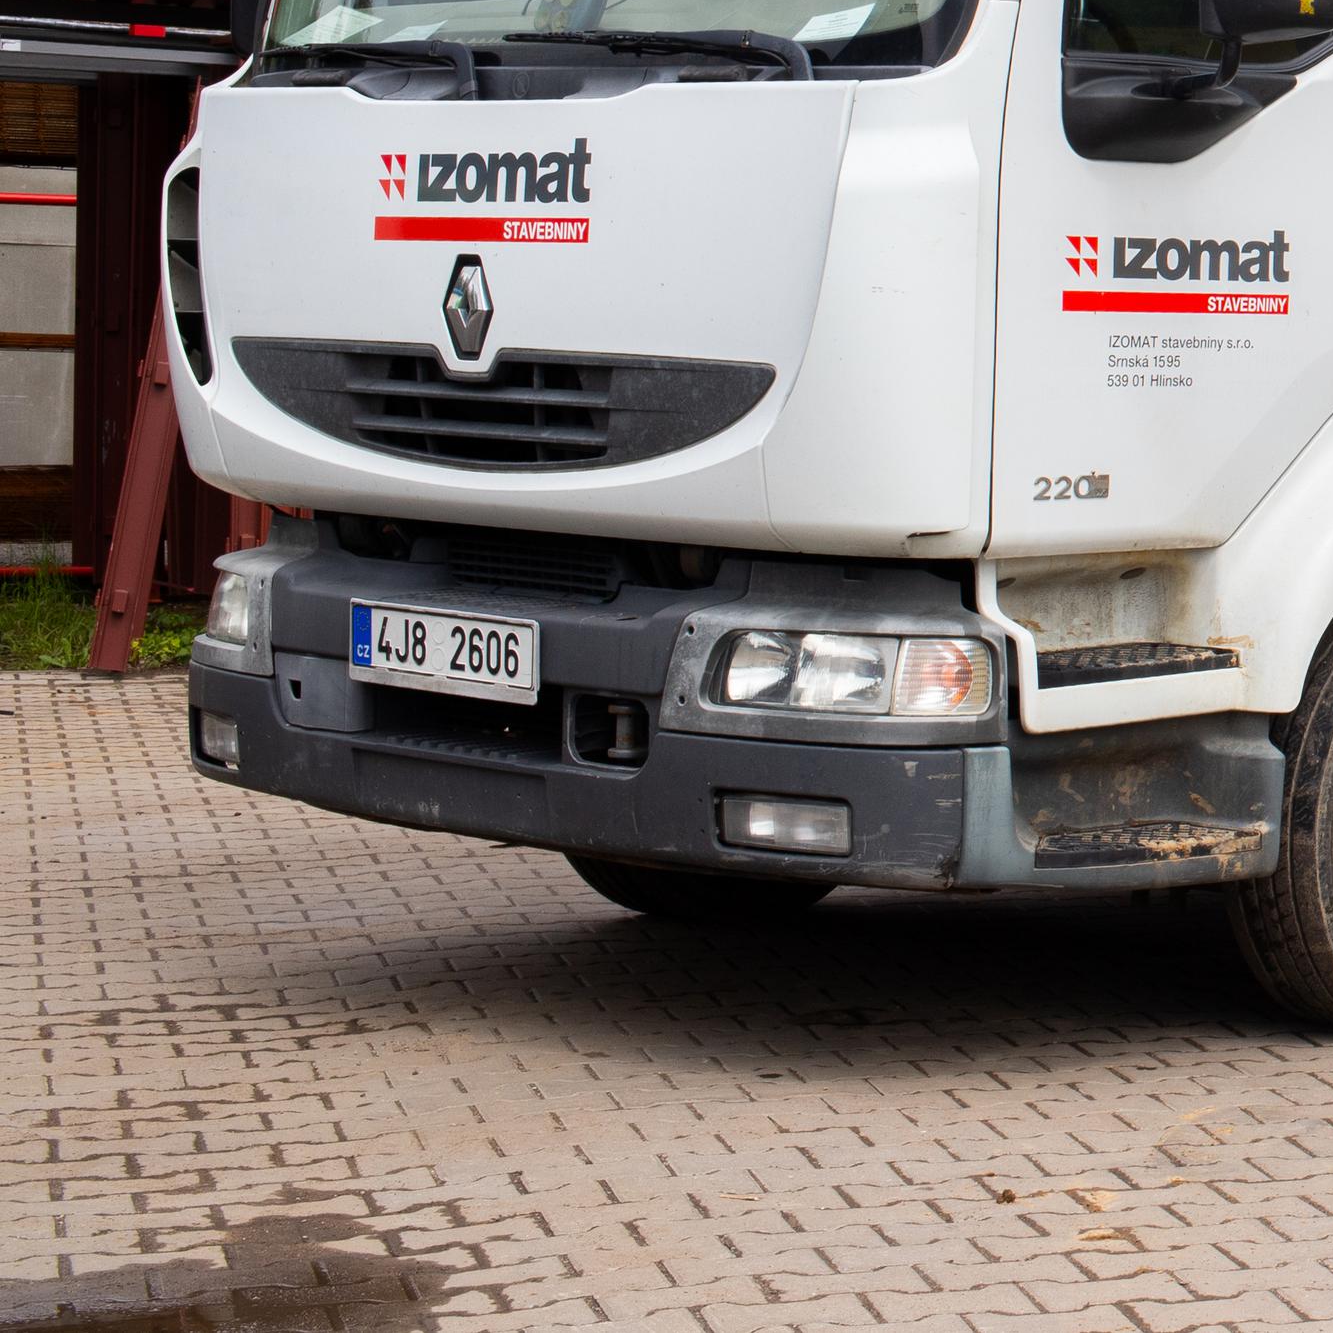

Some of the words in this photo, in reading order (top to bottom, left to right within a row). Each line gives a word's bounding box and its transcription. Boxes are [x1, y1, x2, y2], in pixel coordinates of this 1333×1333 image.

[503, 221, 587, 240] STAVEBNINY
[1207, 296, 1287, 313] STAVEBNINY
[1108, 335, 1158, 349] IZOMAT
[1161, 336, 1224, 352] stavebniny
[1226, 338, 1254, 349] s.r.o.
[1107, 354, 1149, 368] Srnská
[1153, 355, 1181, 368] 1595
[1107, 374, 1129, 387] 539
[1132, 375, 1145, 387] 01
[1150, 374, 1193, 387] Hlinsko
[356, 643, 370, 659] CZ
[377, 616, 427, 666] 4J8
[450, 625, 520, 679] 2606
